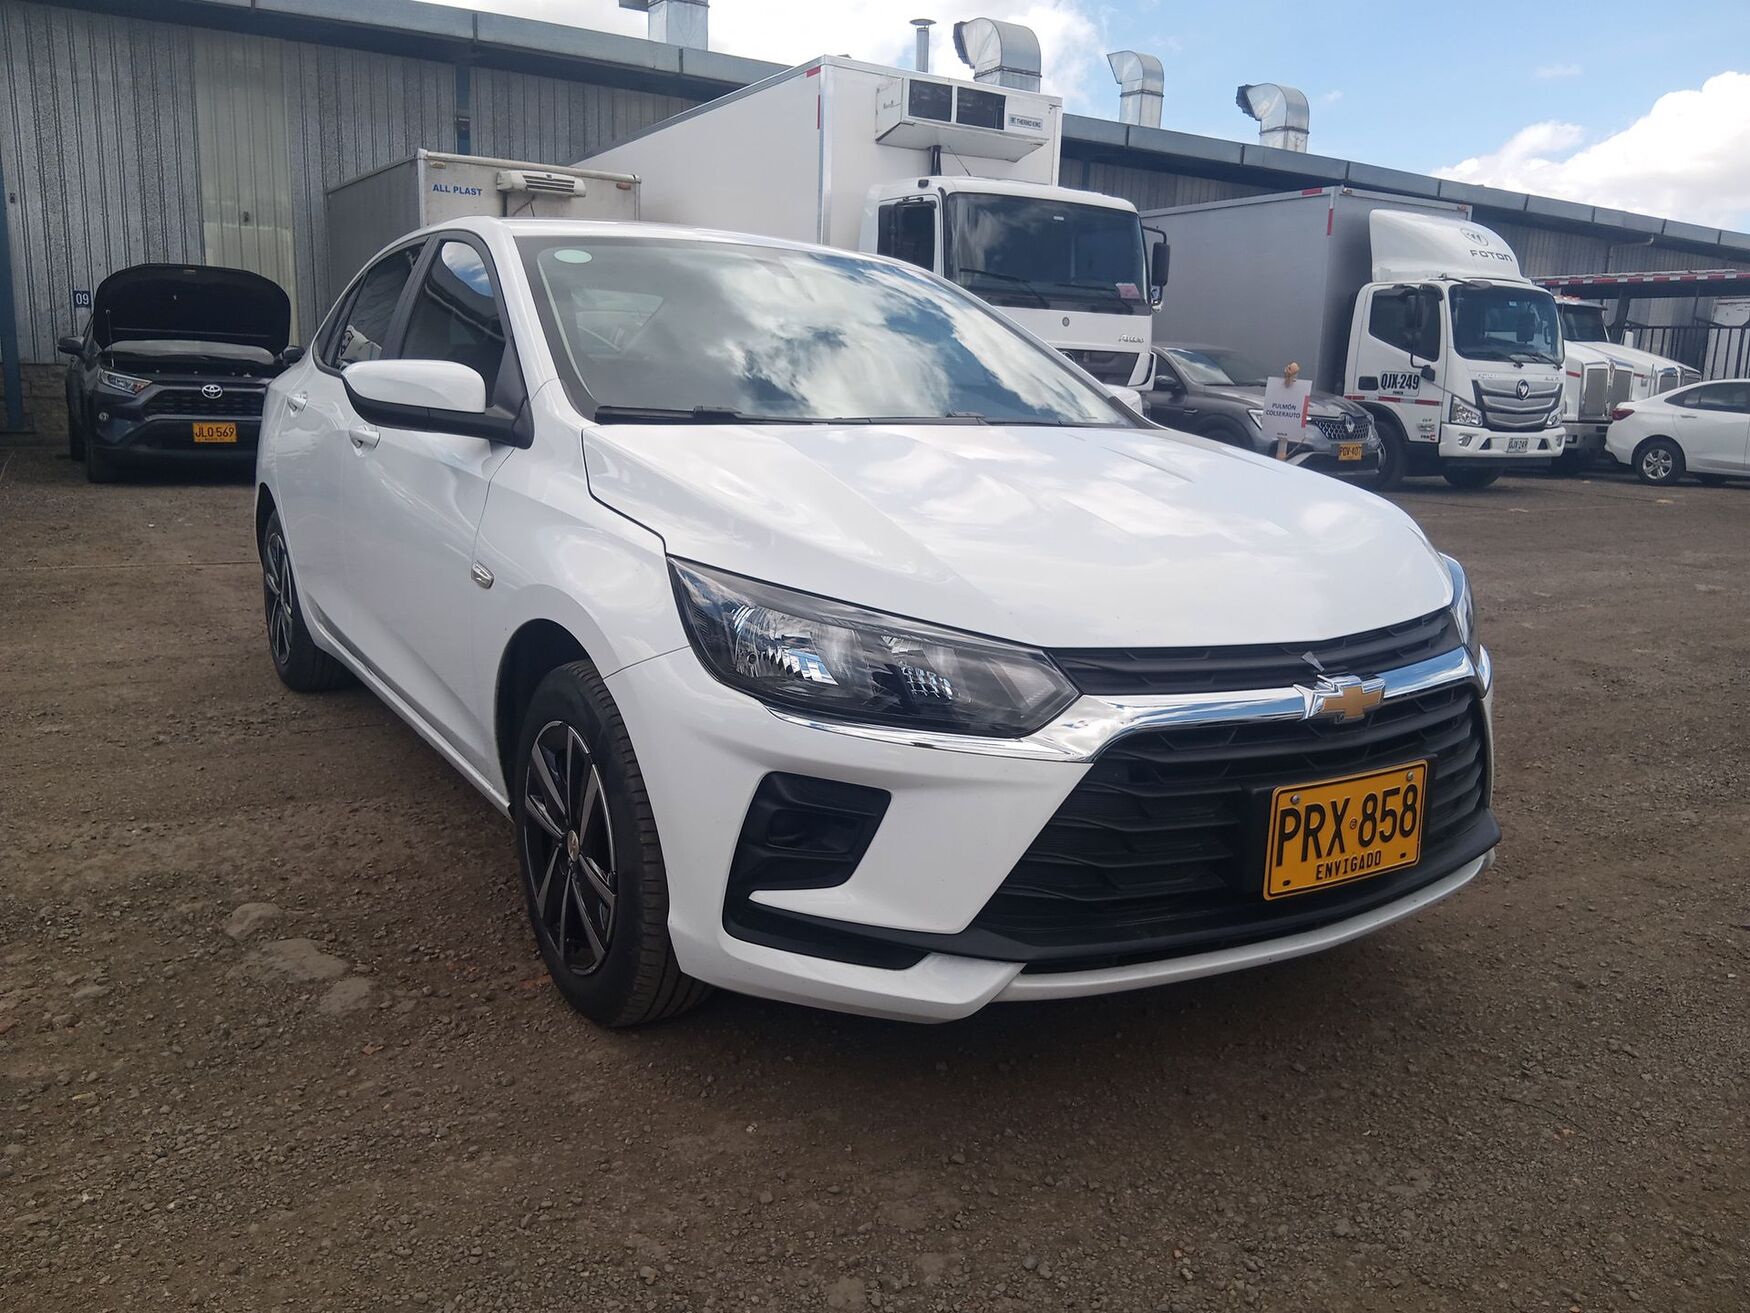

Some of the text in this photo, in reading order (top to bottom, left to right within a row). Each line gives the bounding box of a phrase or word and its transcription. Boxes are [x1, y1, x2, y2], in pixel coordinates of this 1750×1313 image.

[433, 184, 482, 196] ALL PLAST
[76, 293, 89, 305] 09
[1381, 374, 1420, 390] QJX-249
[1266, 410, 1300, 419] COLSERAUTO
[1276, 783, 1418, 867] PRX 858
[1316, 850, 1382, 881] ENVIGADO
